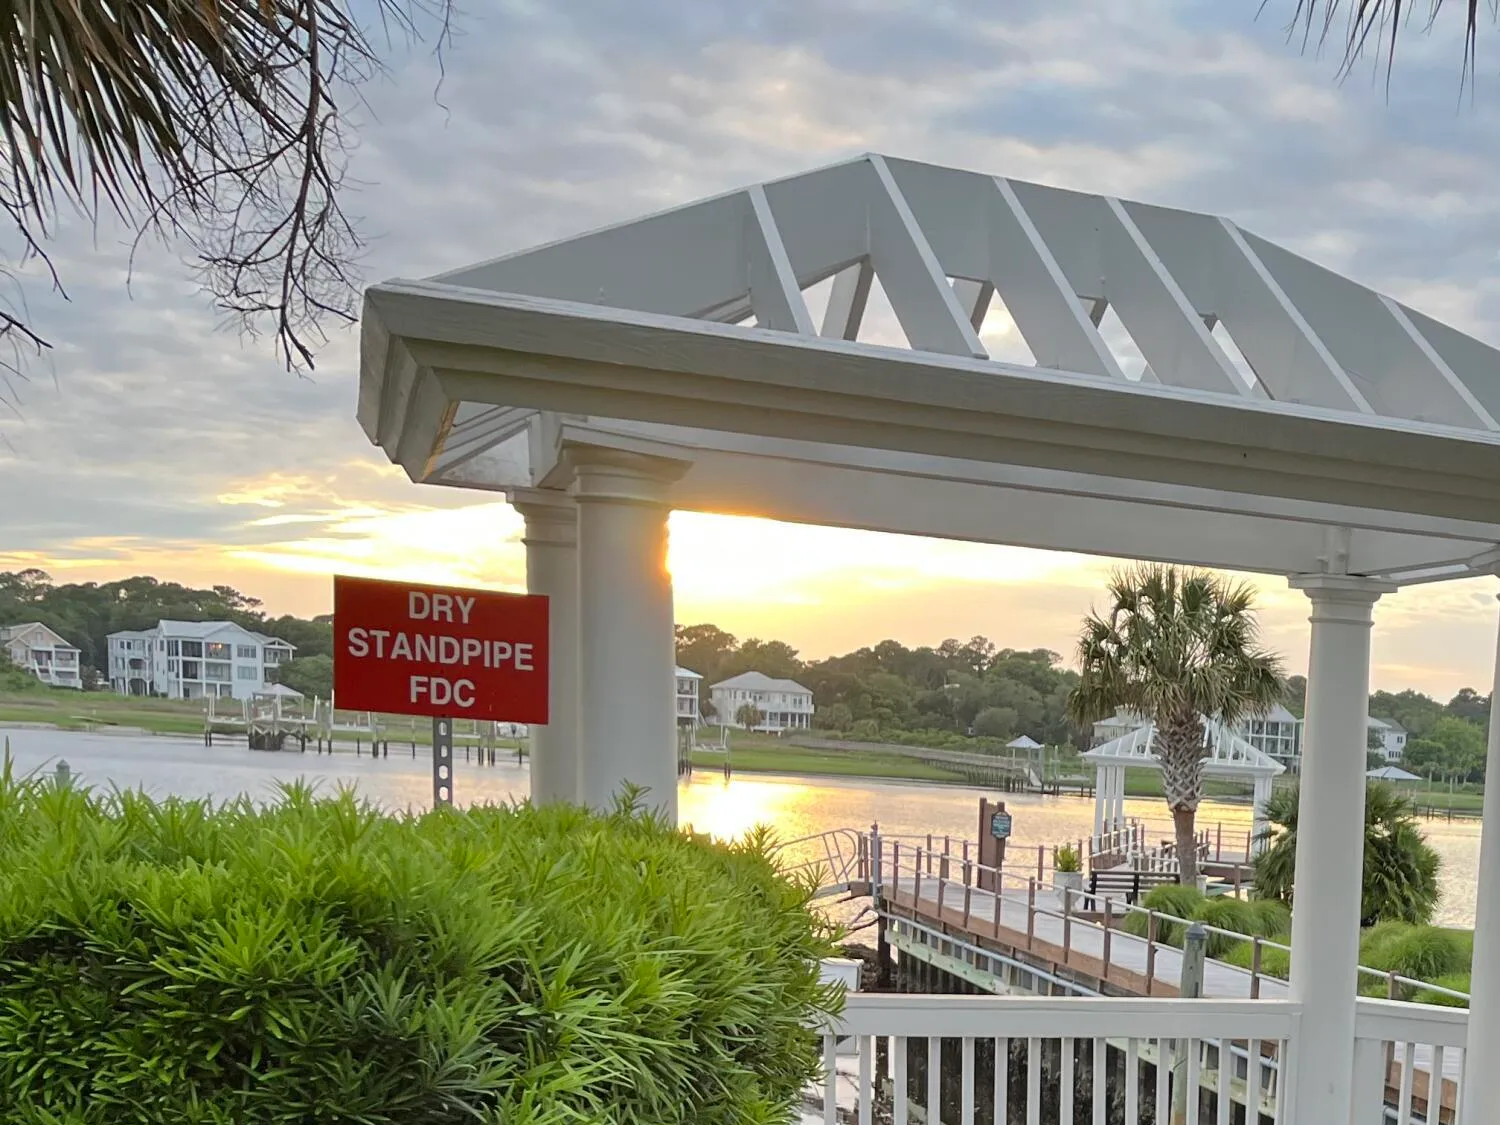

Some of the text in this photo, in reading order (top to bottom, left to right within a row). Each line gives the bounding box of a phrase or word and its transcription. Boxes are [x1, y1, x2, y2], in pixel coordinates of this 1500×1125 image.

[408, 591, 476, 624] DRY
[348, 627, 534, 671] STANDPIPE
[410, 675, 476, 708] FDC
